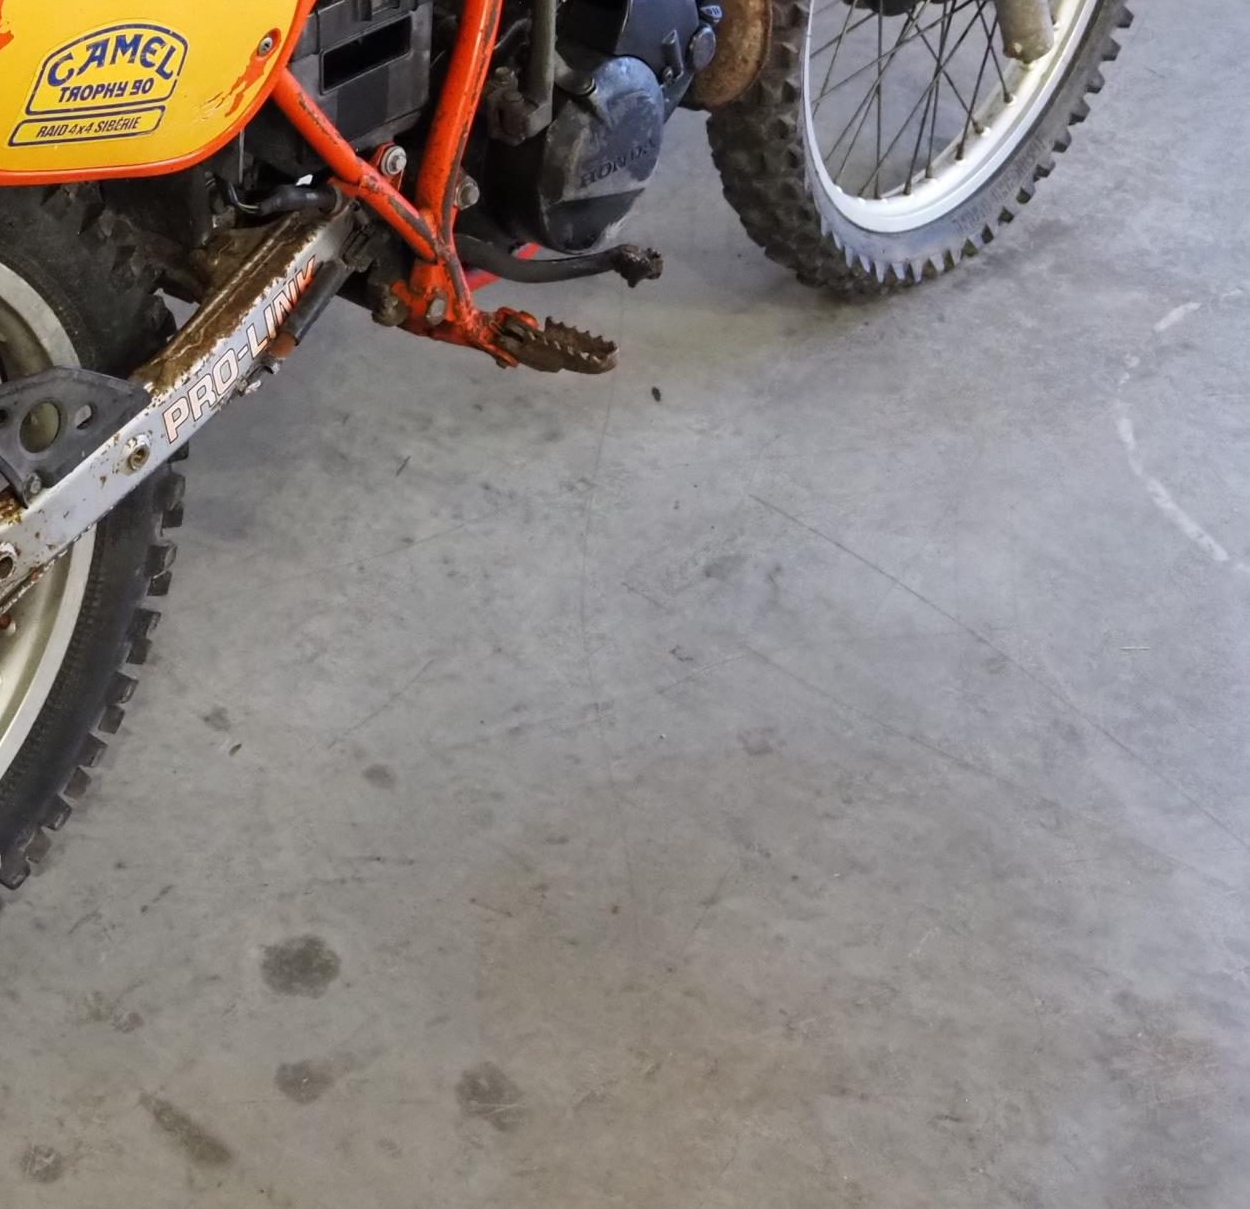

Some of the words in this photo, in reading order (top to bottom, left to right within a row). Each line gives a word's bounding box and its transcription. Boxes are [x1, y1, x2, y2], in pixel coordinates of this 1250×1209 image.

[47, 34, 176, 87] CAMEL
[58, 80, 129, 103] TROPHY
[129, 77, 155, 96] 90
[36, 124, 69, 138] RAID
